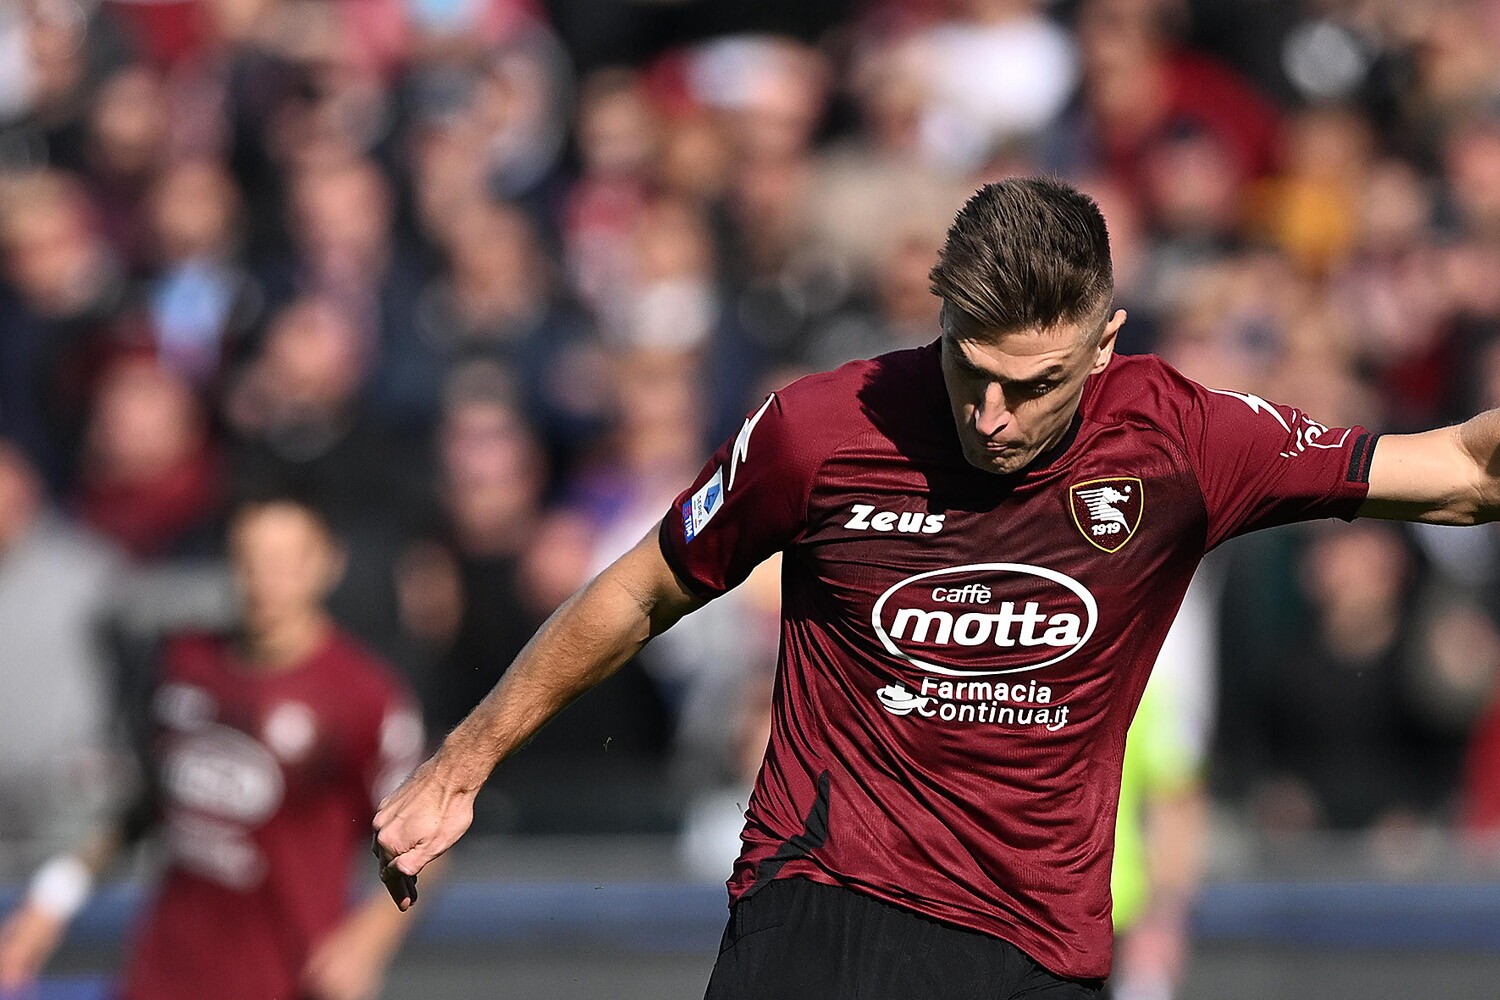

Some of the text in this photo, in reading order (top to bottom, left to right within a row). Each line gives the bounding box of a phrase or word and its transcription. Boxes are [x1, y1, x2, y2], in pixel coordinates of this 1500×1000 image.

[685, 514, 693, 537] TIM
[844, 504, 946, 534] Zeus
[1091, 522, 1121, 536] 1919
[931, 584, 992, 604] caffè
[889, 601, 1082, 647] motta
[920, 676, 1052, 704] Farmacia
